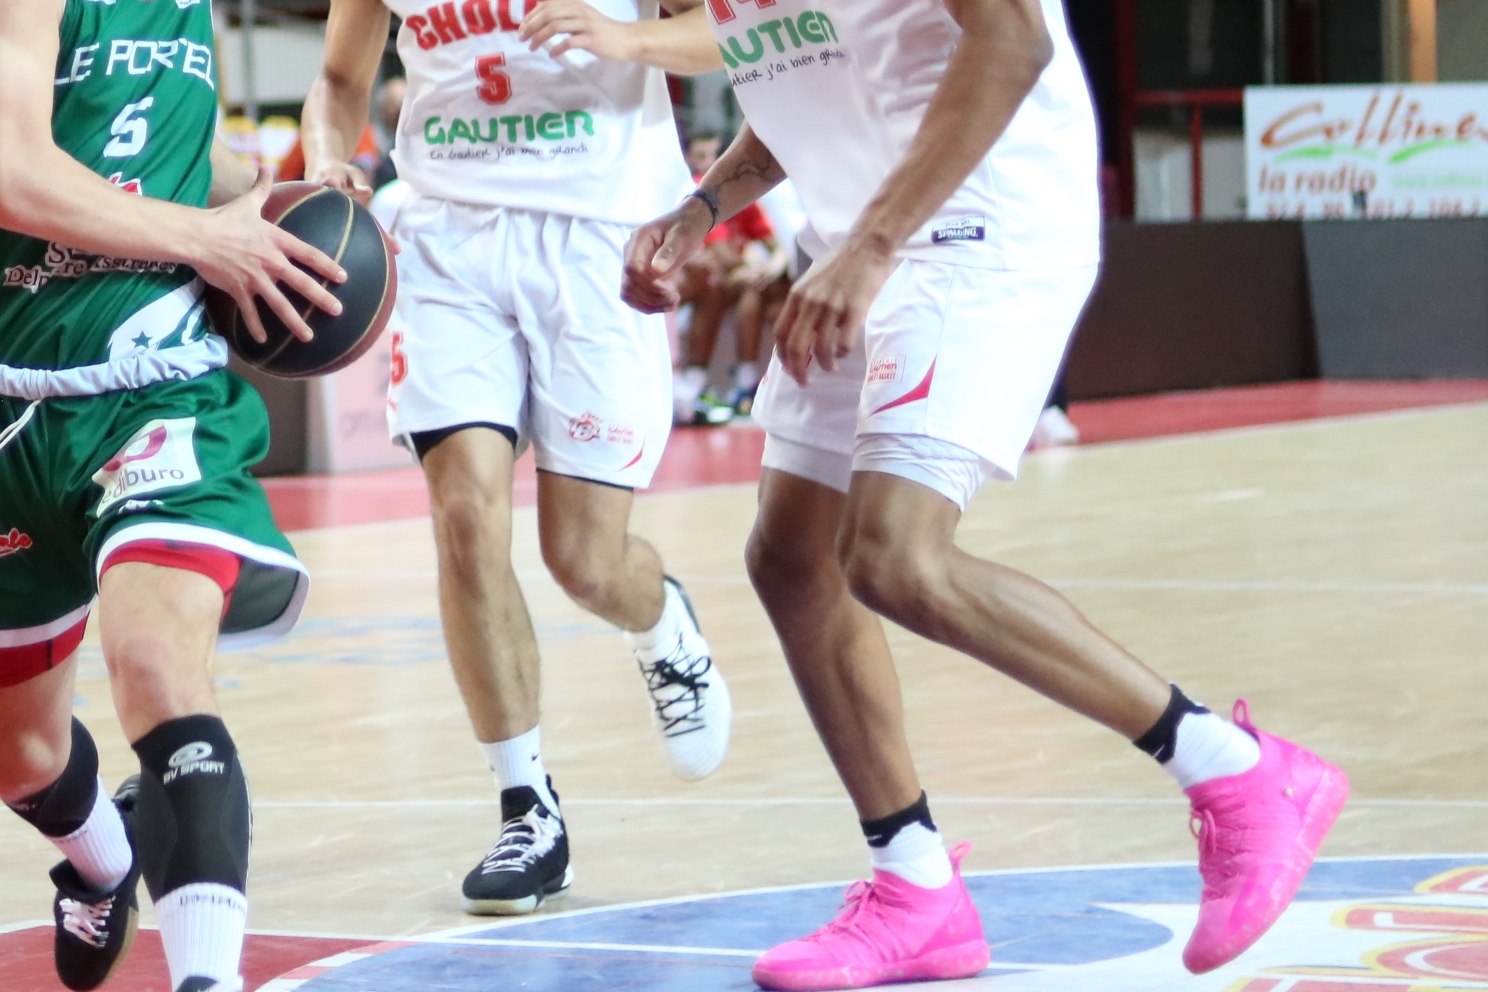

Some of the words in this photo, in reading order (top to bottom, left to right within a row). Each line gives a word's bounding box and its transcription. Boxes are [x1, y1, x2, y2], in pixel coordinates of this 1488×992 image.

[475, 51, 513, 106] 5
[103, 96, 155, 158] 5
[423, 109, 596, 146] GAUTIER
[1294, 159, 1378, 193] radio
[180, 760, 225, 777] SPORT
